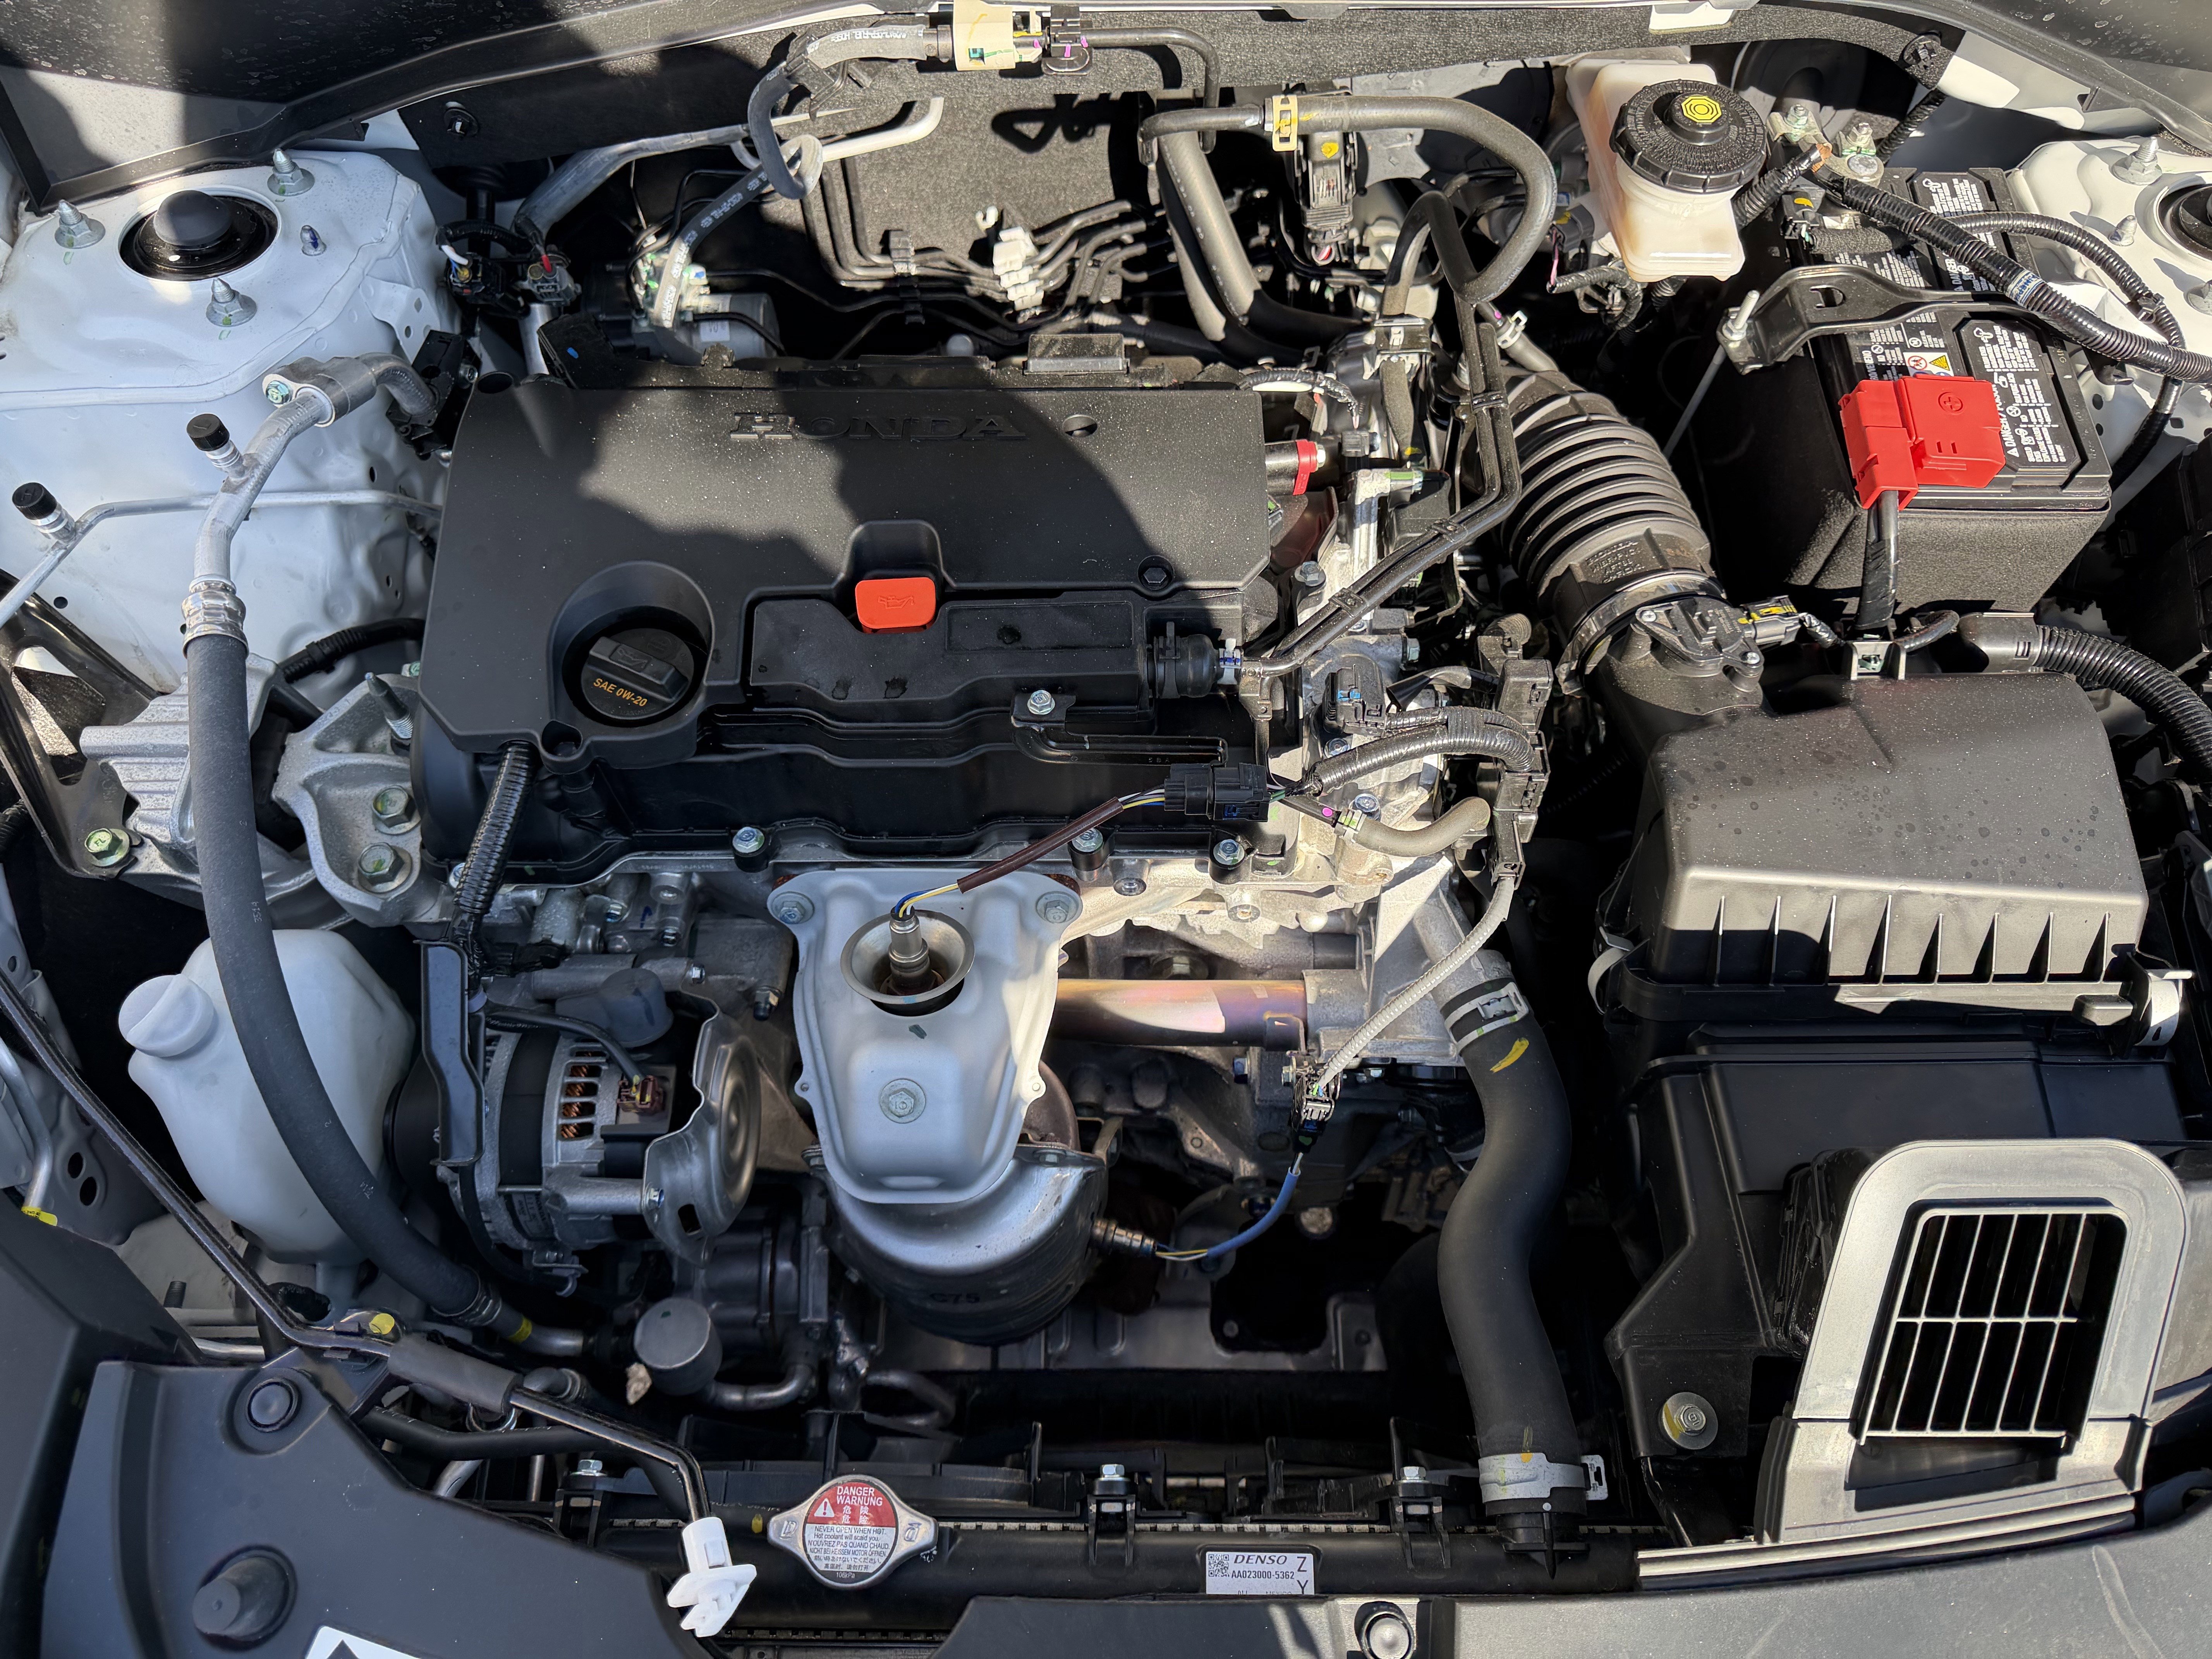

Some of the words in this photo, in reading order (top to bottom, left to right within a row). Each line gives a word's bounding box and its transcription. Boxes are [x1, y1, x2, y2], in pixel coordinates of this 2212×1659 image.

[730, 412, 1026, 440] HONDA
[594, 678, 614, 694] SAE
[616, 688, 647, 707] 0W-20
[929, 1292, 981, 1304] C75
[836, 1495, 883, 1506] WARNUNG
[837, 1486, 875, 1497] DANGER
[1234, 1554, 1287, 1565] DENSO
[1297, 1556, 1307, 1572] Z
[1231, 1571, 1295, 1579] AA023000-5362
[1297, 1580, 1309, 1595] Y
